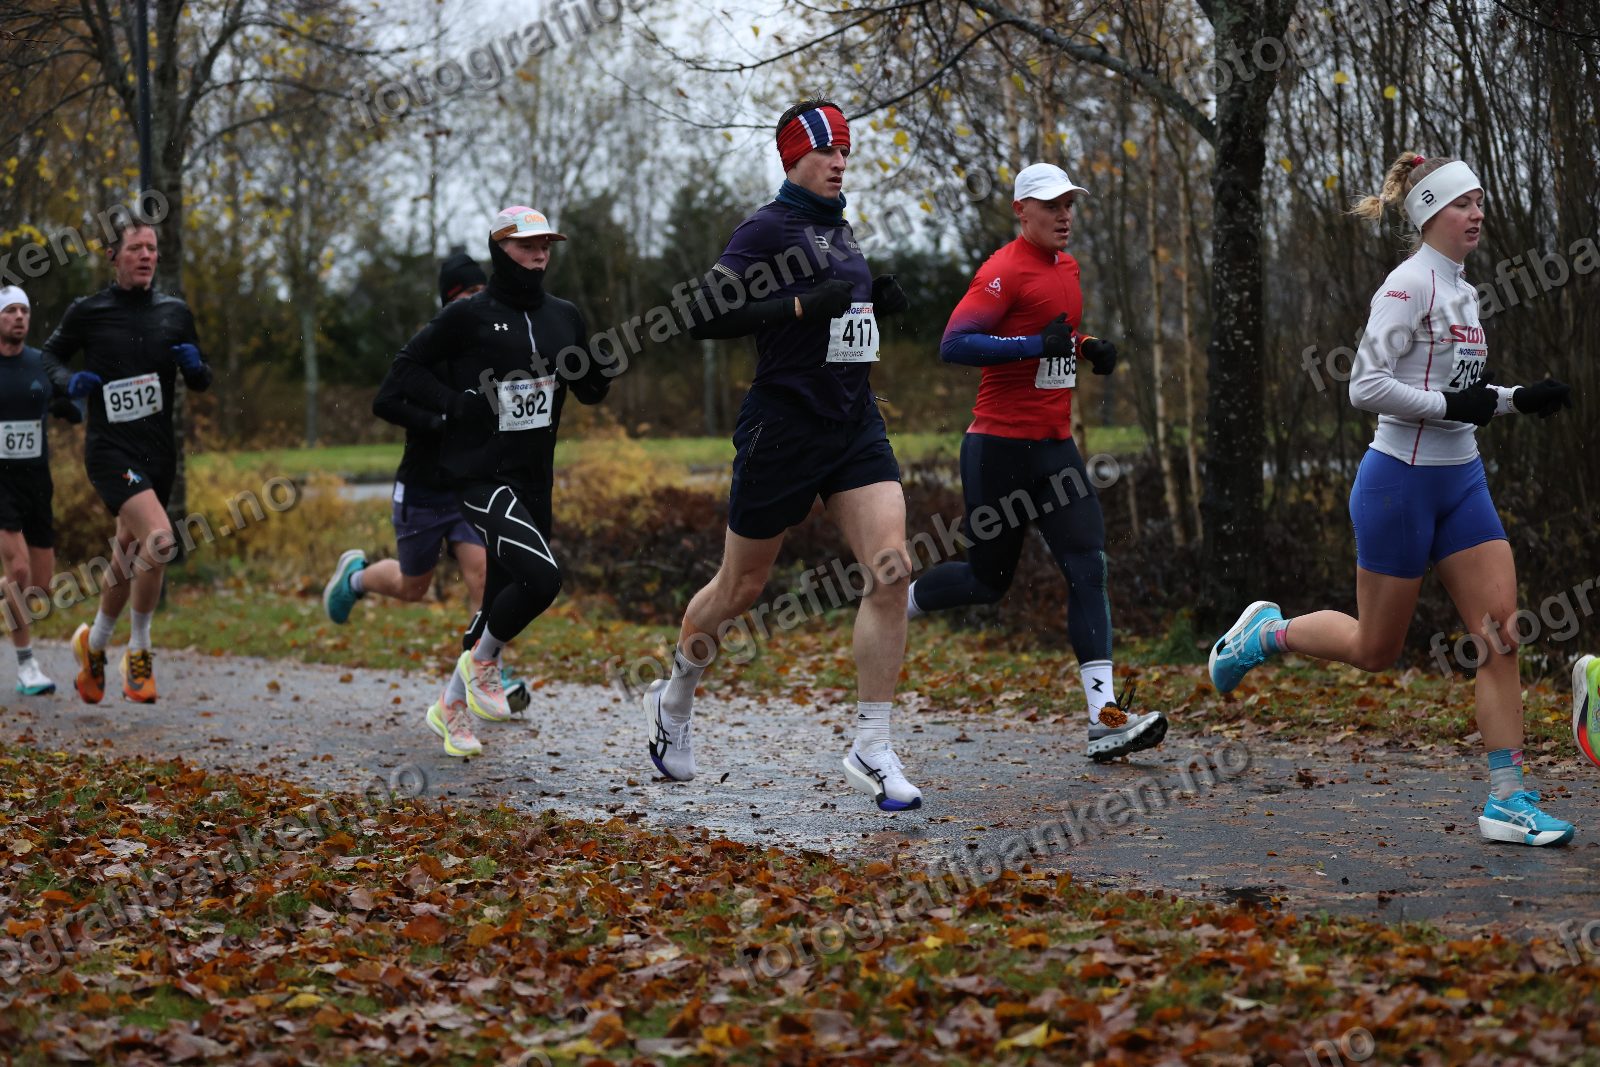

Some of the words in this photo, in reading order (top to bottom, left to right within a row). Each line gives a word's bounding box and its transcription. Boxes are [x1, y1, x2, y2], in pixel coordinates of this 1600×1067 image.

[842, 319, 871, 347] 417
[110, 385, 156, 412] 9512
[511, 390, 547, 418] 362
[6, 432, 34, 450] 675
